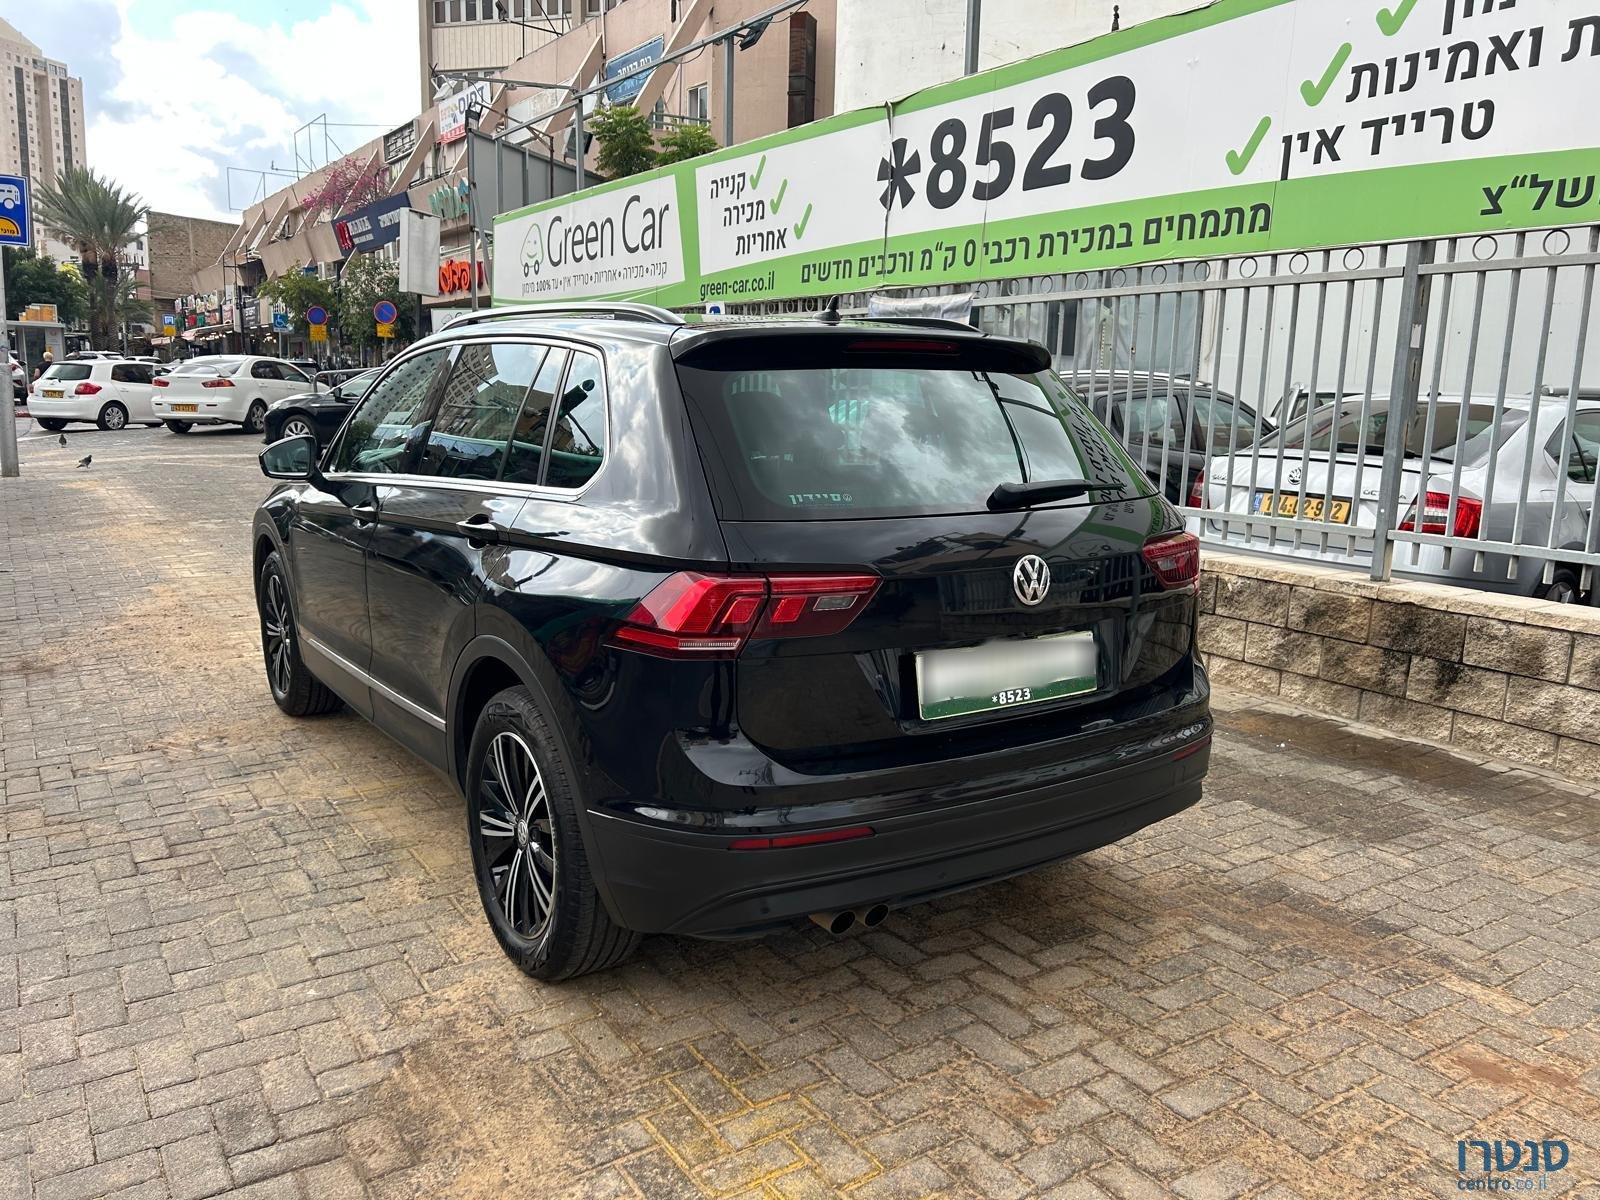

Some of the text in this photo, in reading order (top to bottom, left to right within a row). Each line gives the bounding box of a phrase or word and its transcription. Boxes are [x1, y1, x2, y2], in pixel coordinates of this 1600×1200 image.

[1345, 26, 1544, 103] ואמינות
[1280, 99, 1495, 181] טרייד אין
[710, 172, 746, 199] קנייה
[1480, 173, 1600, 216] של"צ
[723, 199, 765, 227] מכירה
[1143, 202, 1271, 245] מתמחים
[547, 195, 669, 267] Green Car
[735, 228, 787, 256] אחריות
[1037, 222, 1133, 259] במכירת
[858, 251, 914, 278] ורכבים
[963, 238, 976, 267] 0
[983, 236, 1030, 265] רכבי
[562, 275, 571, 291] אין
[573, 272, 589, 287] טרייד
[594, 269, 618, 283] אחריות
[622, 265, 644, 280] מכירה
[650, 261, 668, 279] קניה
[801, 259, 852, 284] חדשים
[536, 279, 551, 292] 100%
[700, 271, 775, 301] green-car.co.il
